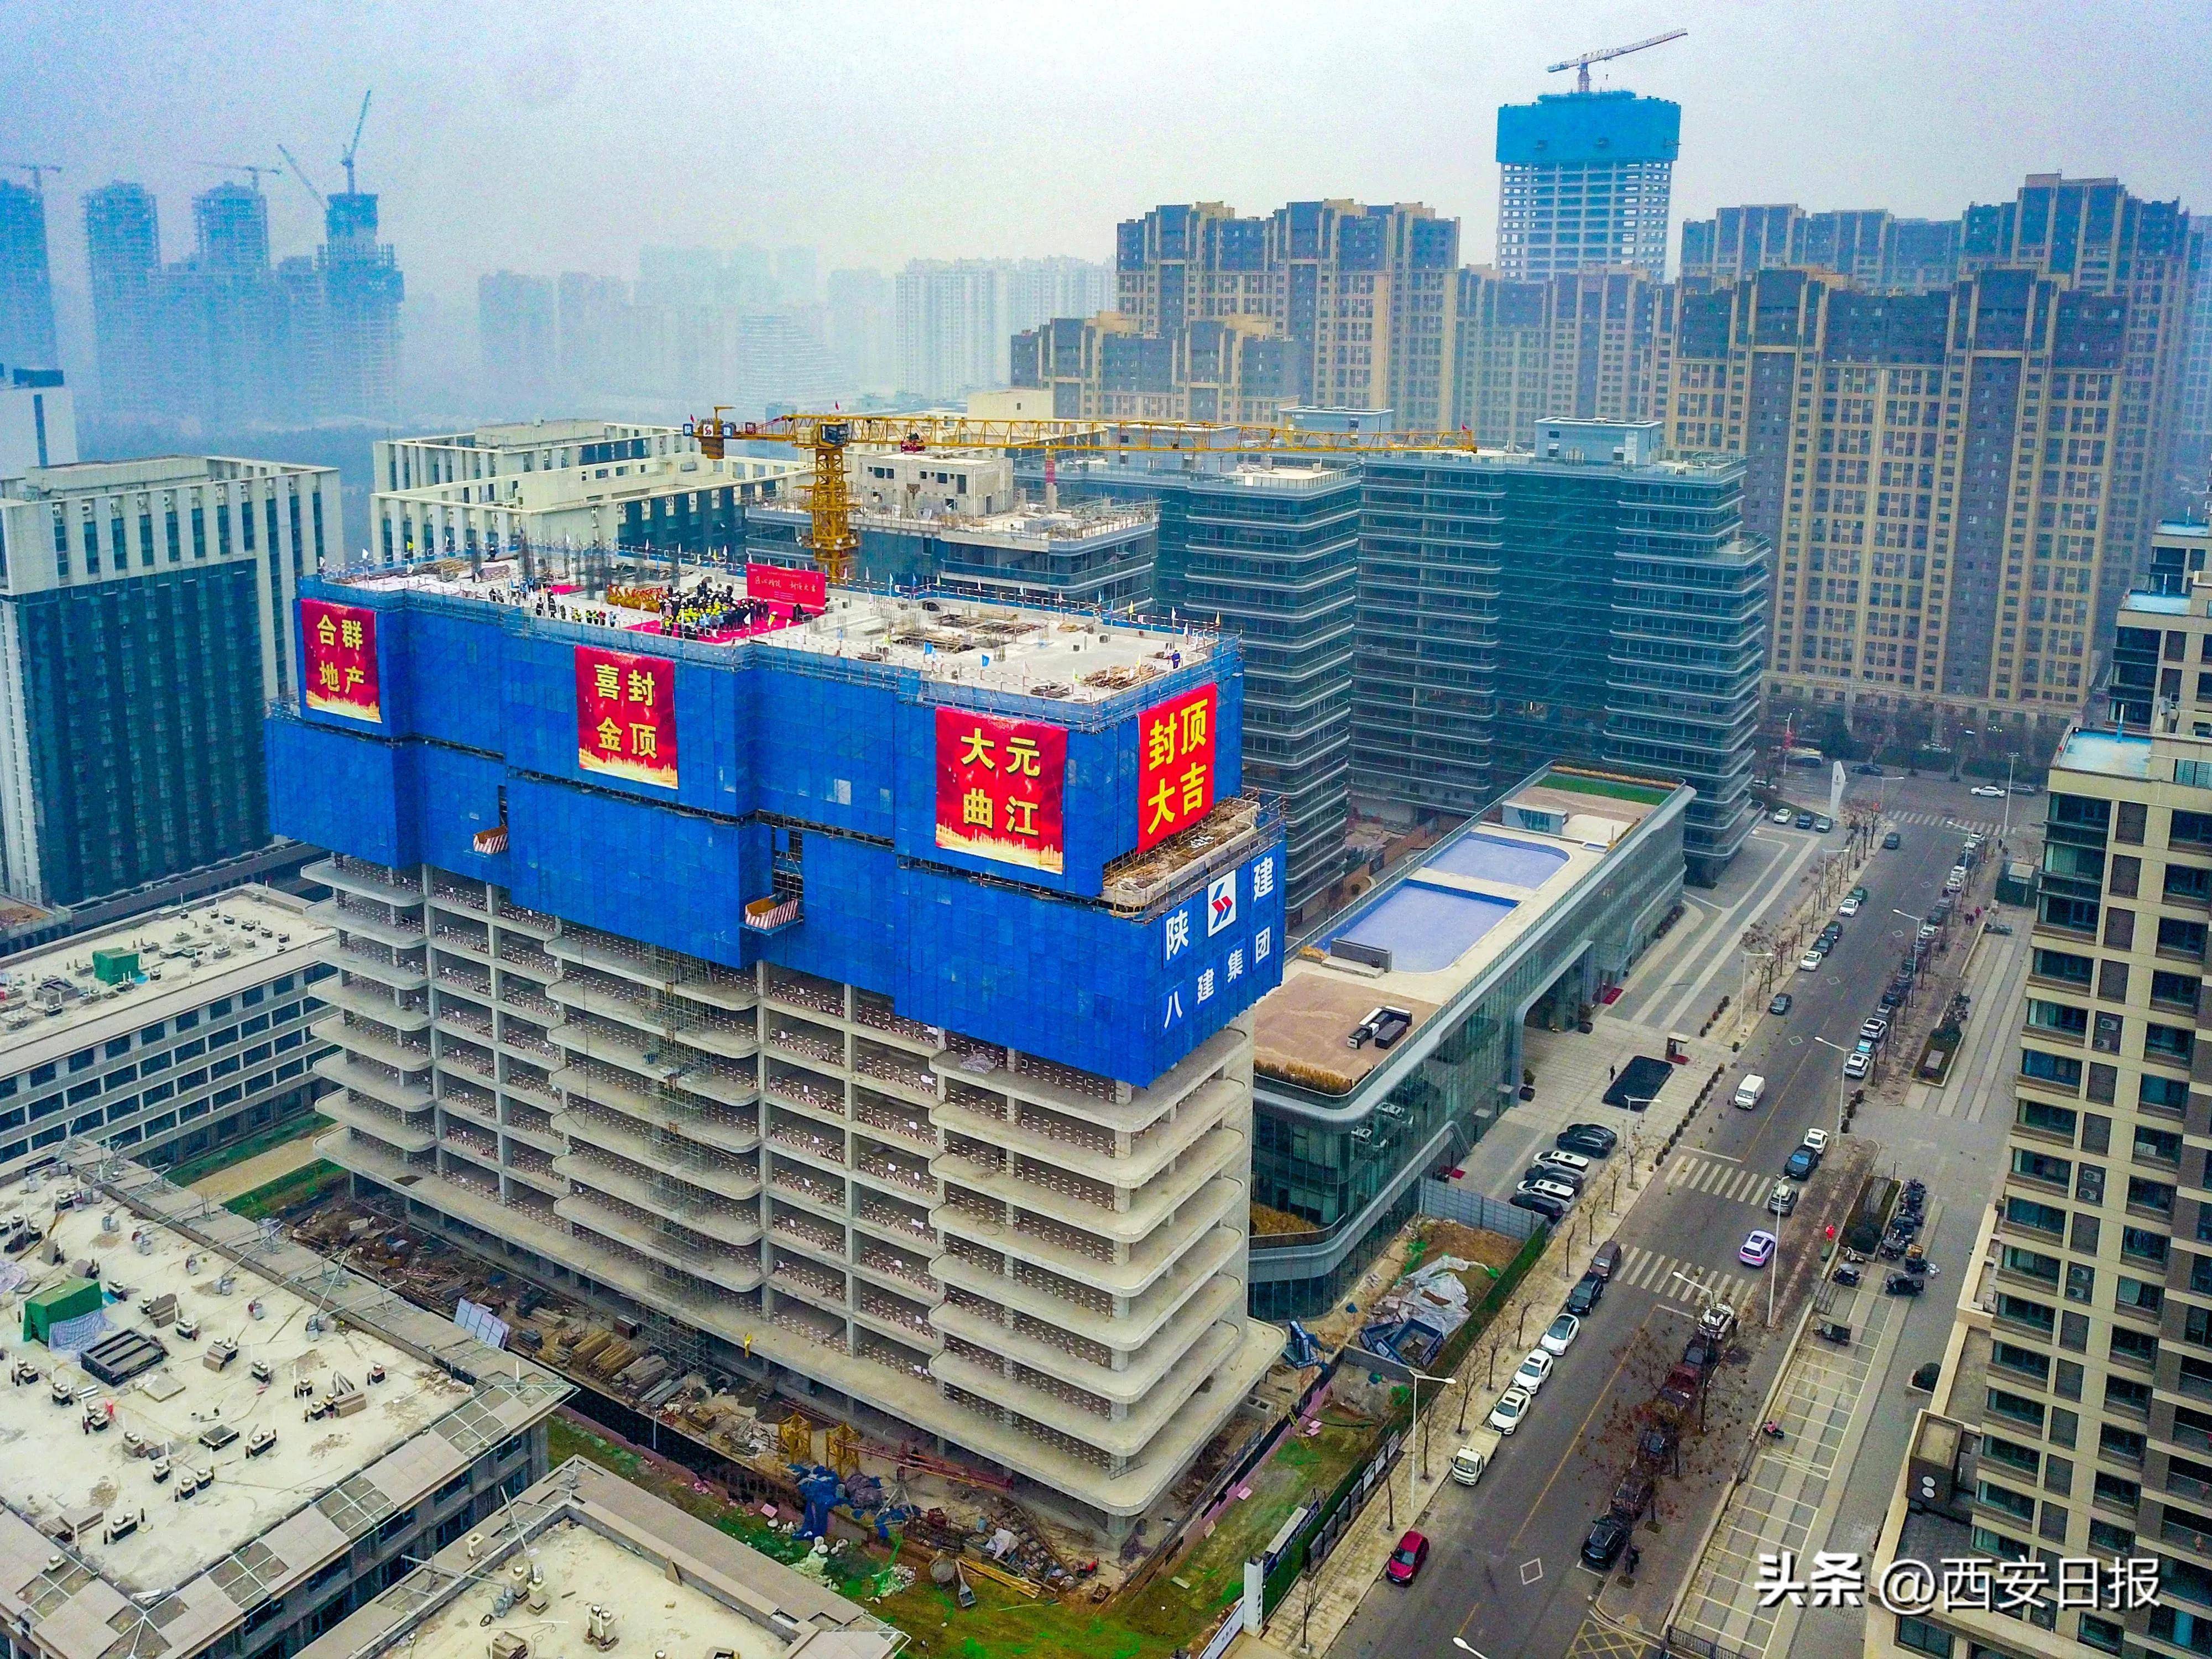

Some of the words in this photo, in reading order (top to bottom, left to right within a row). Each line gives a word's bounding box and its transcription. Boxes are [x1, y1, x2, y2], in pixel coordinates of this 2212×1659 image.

[316, 614, 363, 651] 合群
[319, 660, 364, 695] 地产
[594, 664, 655, 706] 喜封
[596, 716, 658, 759] 金顶
[960, 727, 1041, 777] 大元
[1149, 698, 1208, 771] 封顶
[963, 787, 1039, 836] 曲江
[1147, 761, 1207, 835] 大吉
